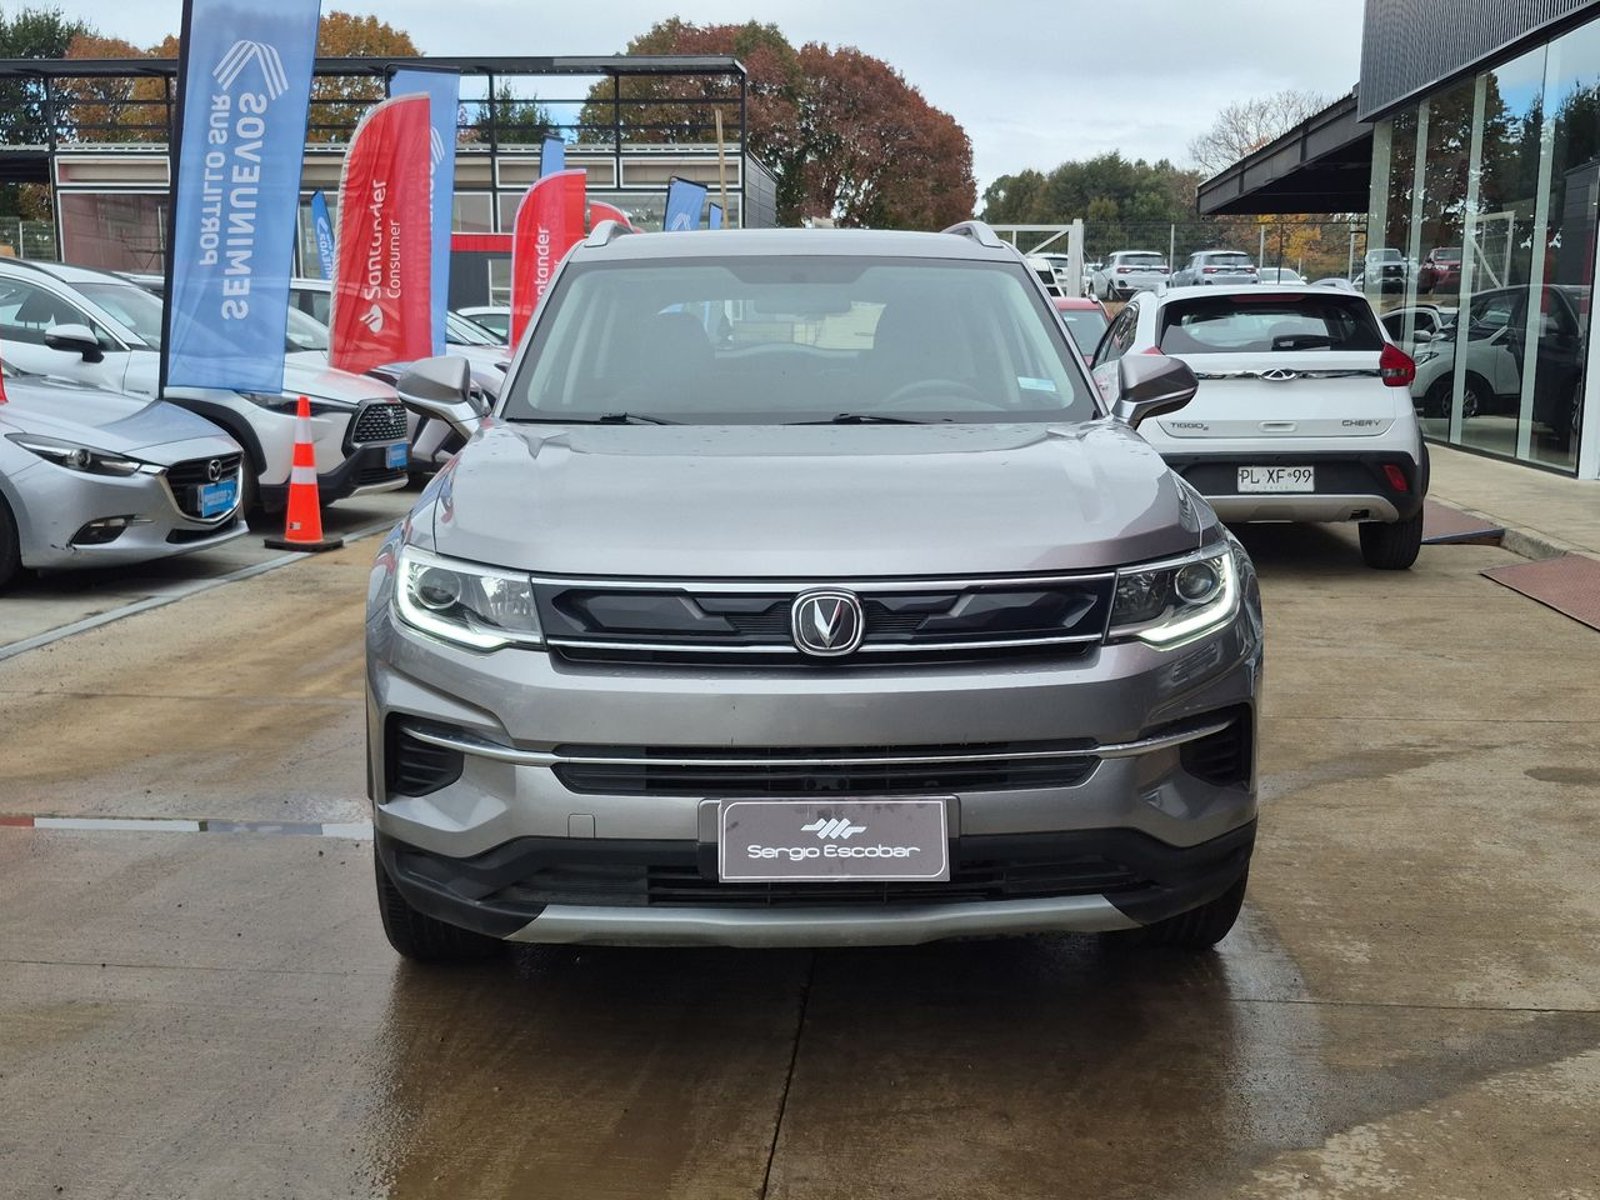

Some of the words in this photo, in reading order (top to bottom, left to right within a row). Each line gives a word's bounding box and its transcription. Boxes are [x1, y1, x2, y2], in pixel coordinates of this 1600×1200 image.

[387, 219, 401, 299] Consumer
[534, 225, 551, 300] ntander
[1342, 419, 1382, 427] CHERY
[747, 844, 820, 861] Sergio
[823, 844, 921, 858] Escobar
